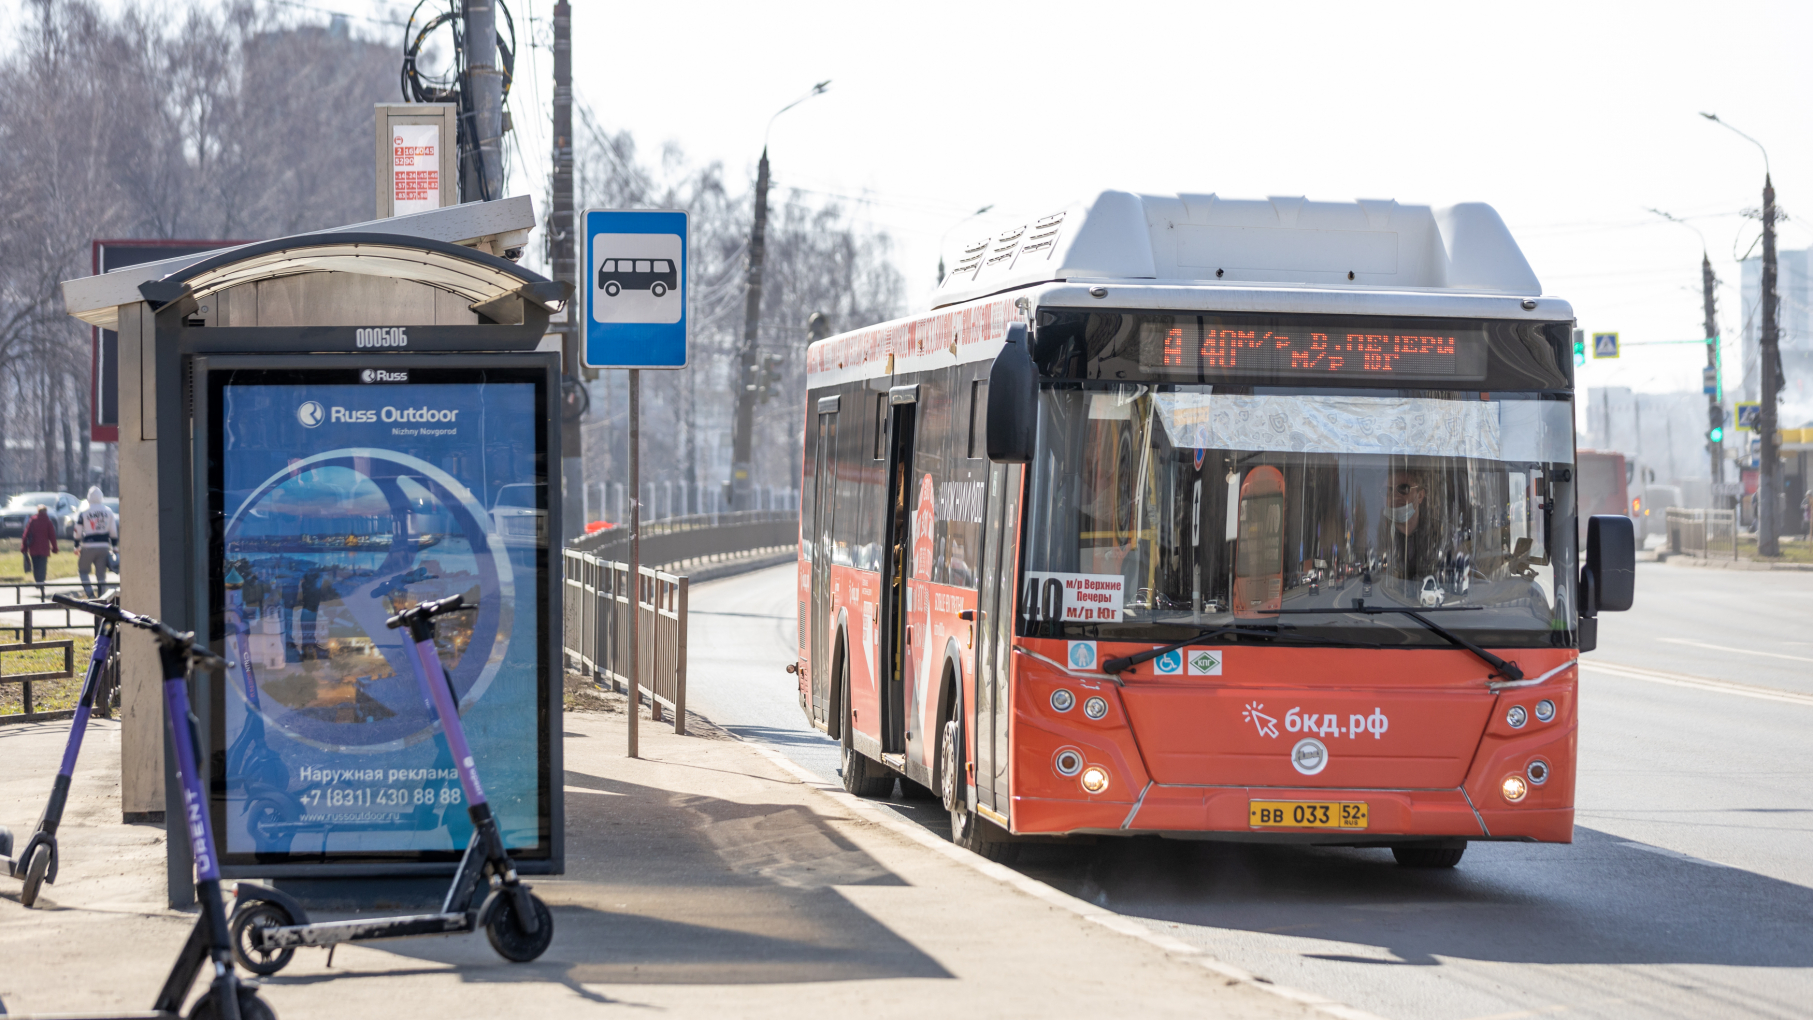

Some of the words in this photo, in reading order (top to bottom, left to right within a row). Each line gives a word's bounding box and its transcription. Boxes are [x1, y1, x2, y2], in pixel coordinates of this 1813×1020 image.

[1201, 330, 1237, 367] 40
[376, 370, 408, 381] Russ
[331, 406, 377, 422] Russ
[381, 406, 459, 422] Outdoor
[392, 428, 418, 436] Nizhny
[420, 428, 457, 436] Novgorod
[1022, 578, 1063, 621] 40
[1066, 578, 1082, 589] м/р
[1084, 579, 1121, 591] Верхние
[1077, 591, 1111, 603] Печеры
[1097, 607, 1116, 619] Юг
[1284, 706, 1389, 739] бкд.рф
[300, 766, 383, 784] Наружная
[388, 768, 458, 784] реклама
[300, 789, 321, 806] +7
[327, 788, 371, 807] (831)
[376, 788, 408, 806] 430
[414, 789, 434, 805] 88
[439, 788, 461, 804] 88
[300, 811, 399, 821] www.russoutdoor.ru
[1294, 806, 1330, 823] 033
[1342, 805, 1360, 819] 52
[184, 788, 210, 873] URENT
